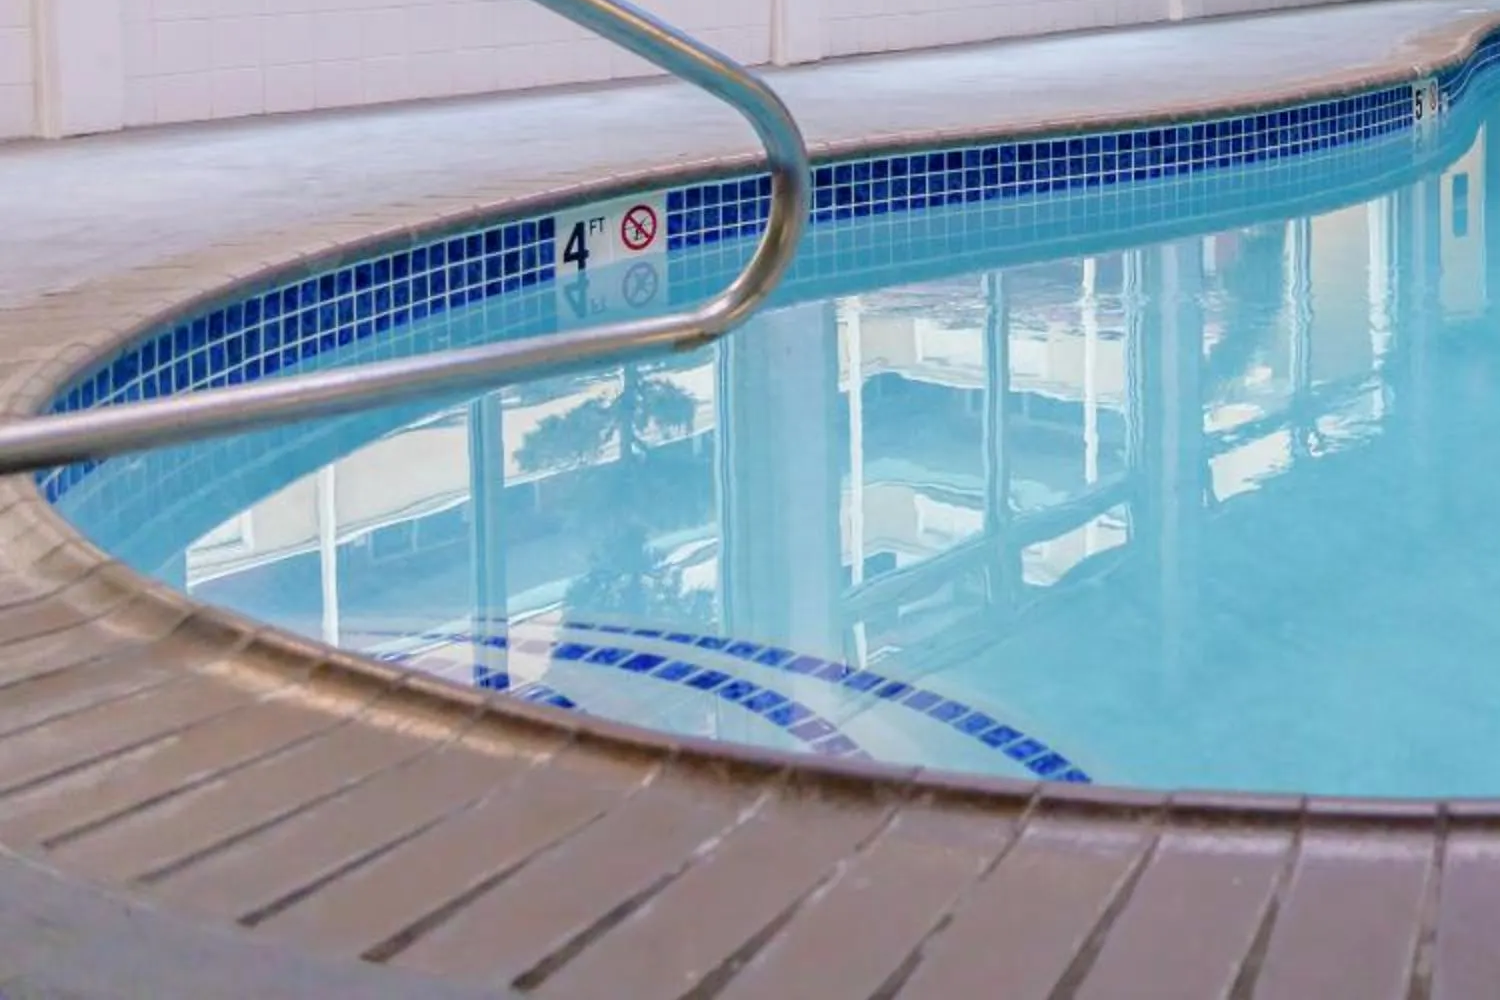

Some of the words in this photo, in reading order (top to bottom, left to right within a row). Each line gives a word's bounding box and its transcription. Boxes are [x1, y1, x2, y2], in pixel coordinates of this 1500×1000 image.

[1415, 89, 1423, 120] 5
[563, 221, 589, 271] 4
[589, 216, 606, 237] FT
